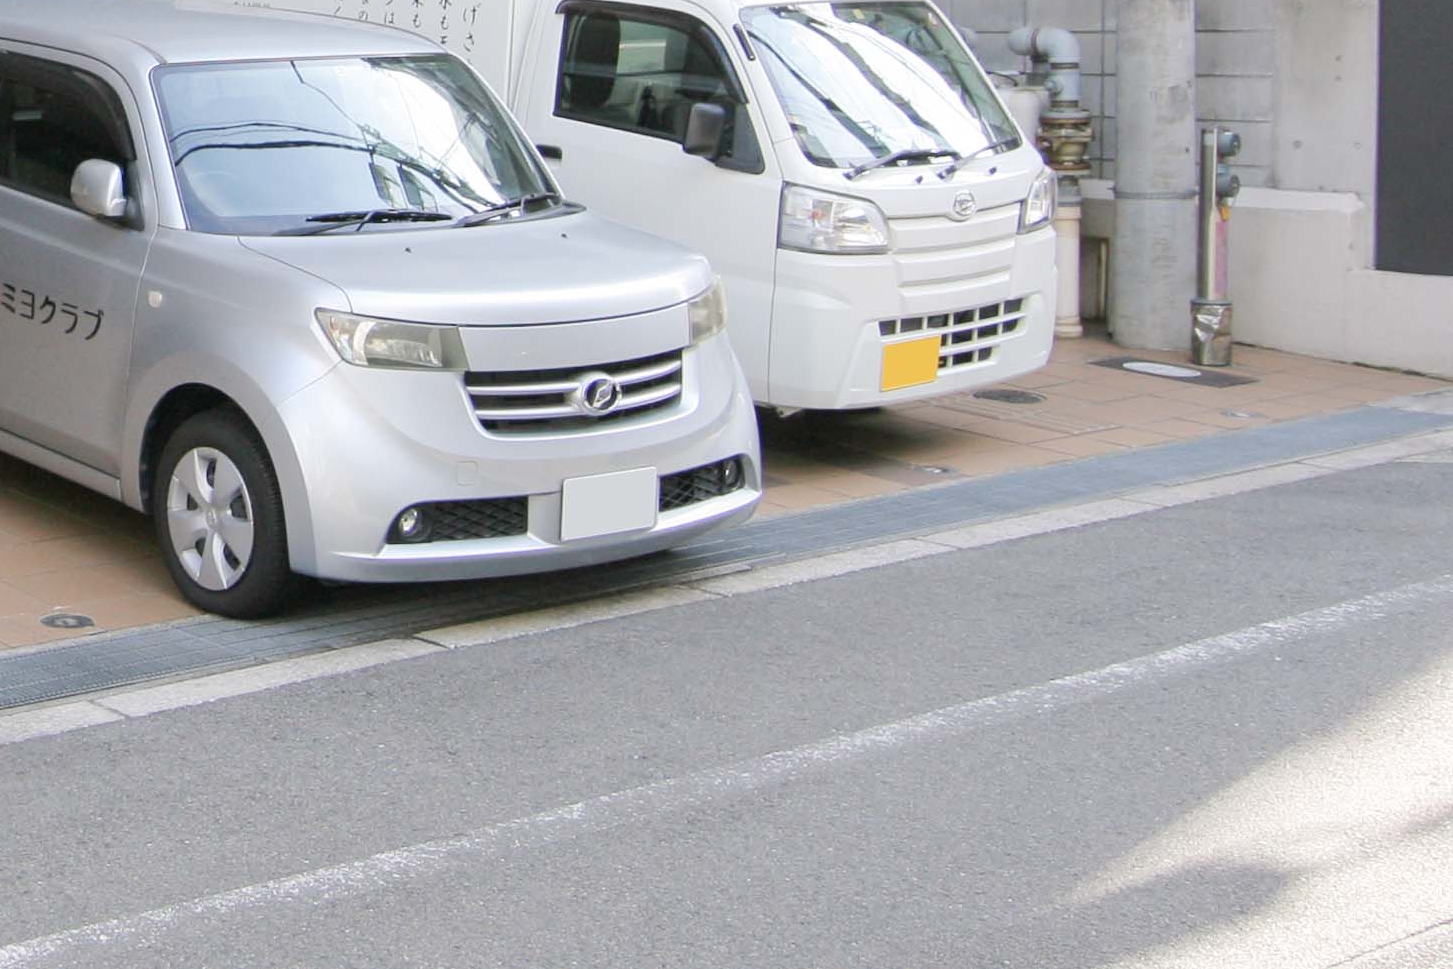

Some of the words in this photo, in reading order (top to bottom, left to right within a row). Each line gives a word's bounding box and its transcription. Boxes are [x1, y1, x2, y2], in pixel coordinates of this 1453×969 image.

[0, 282, 105, 341] ミヨクラブ
